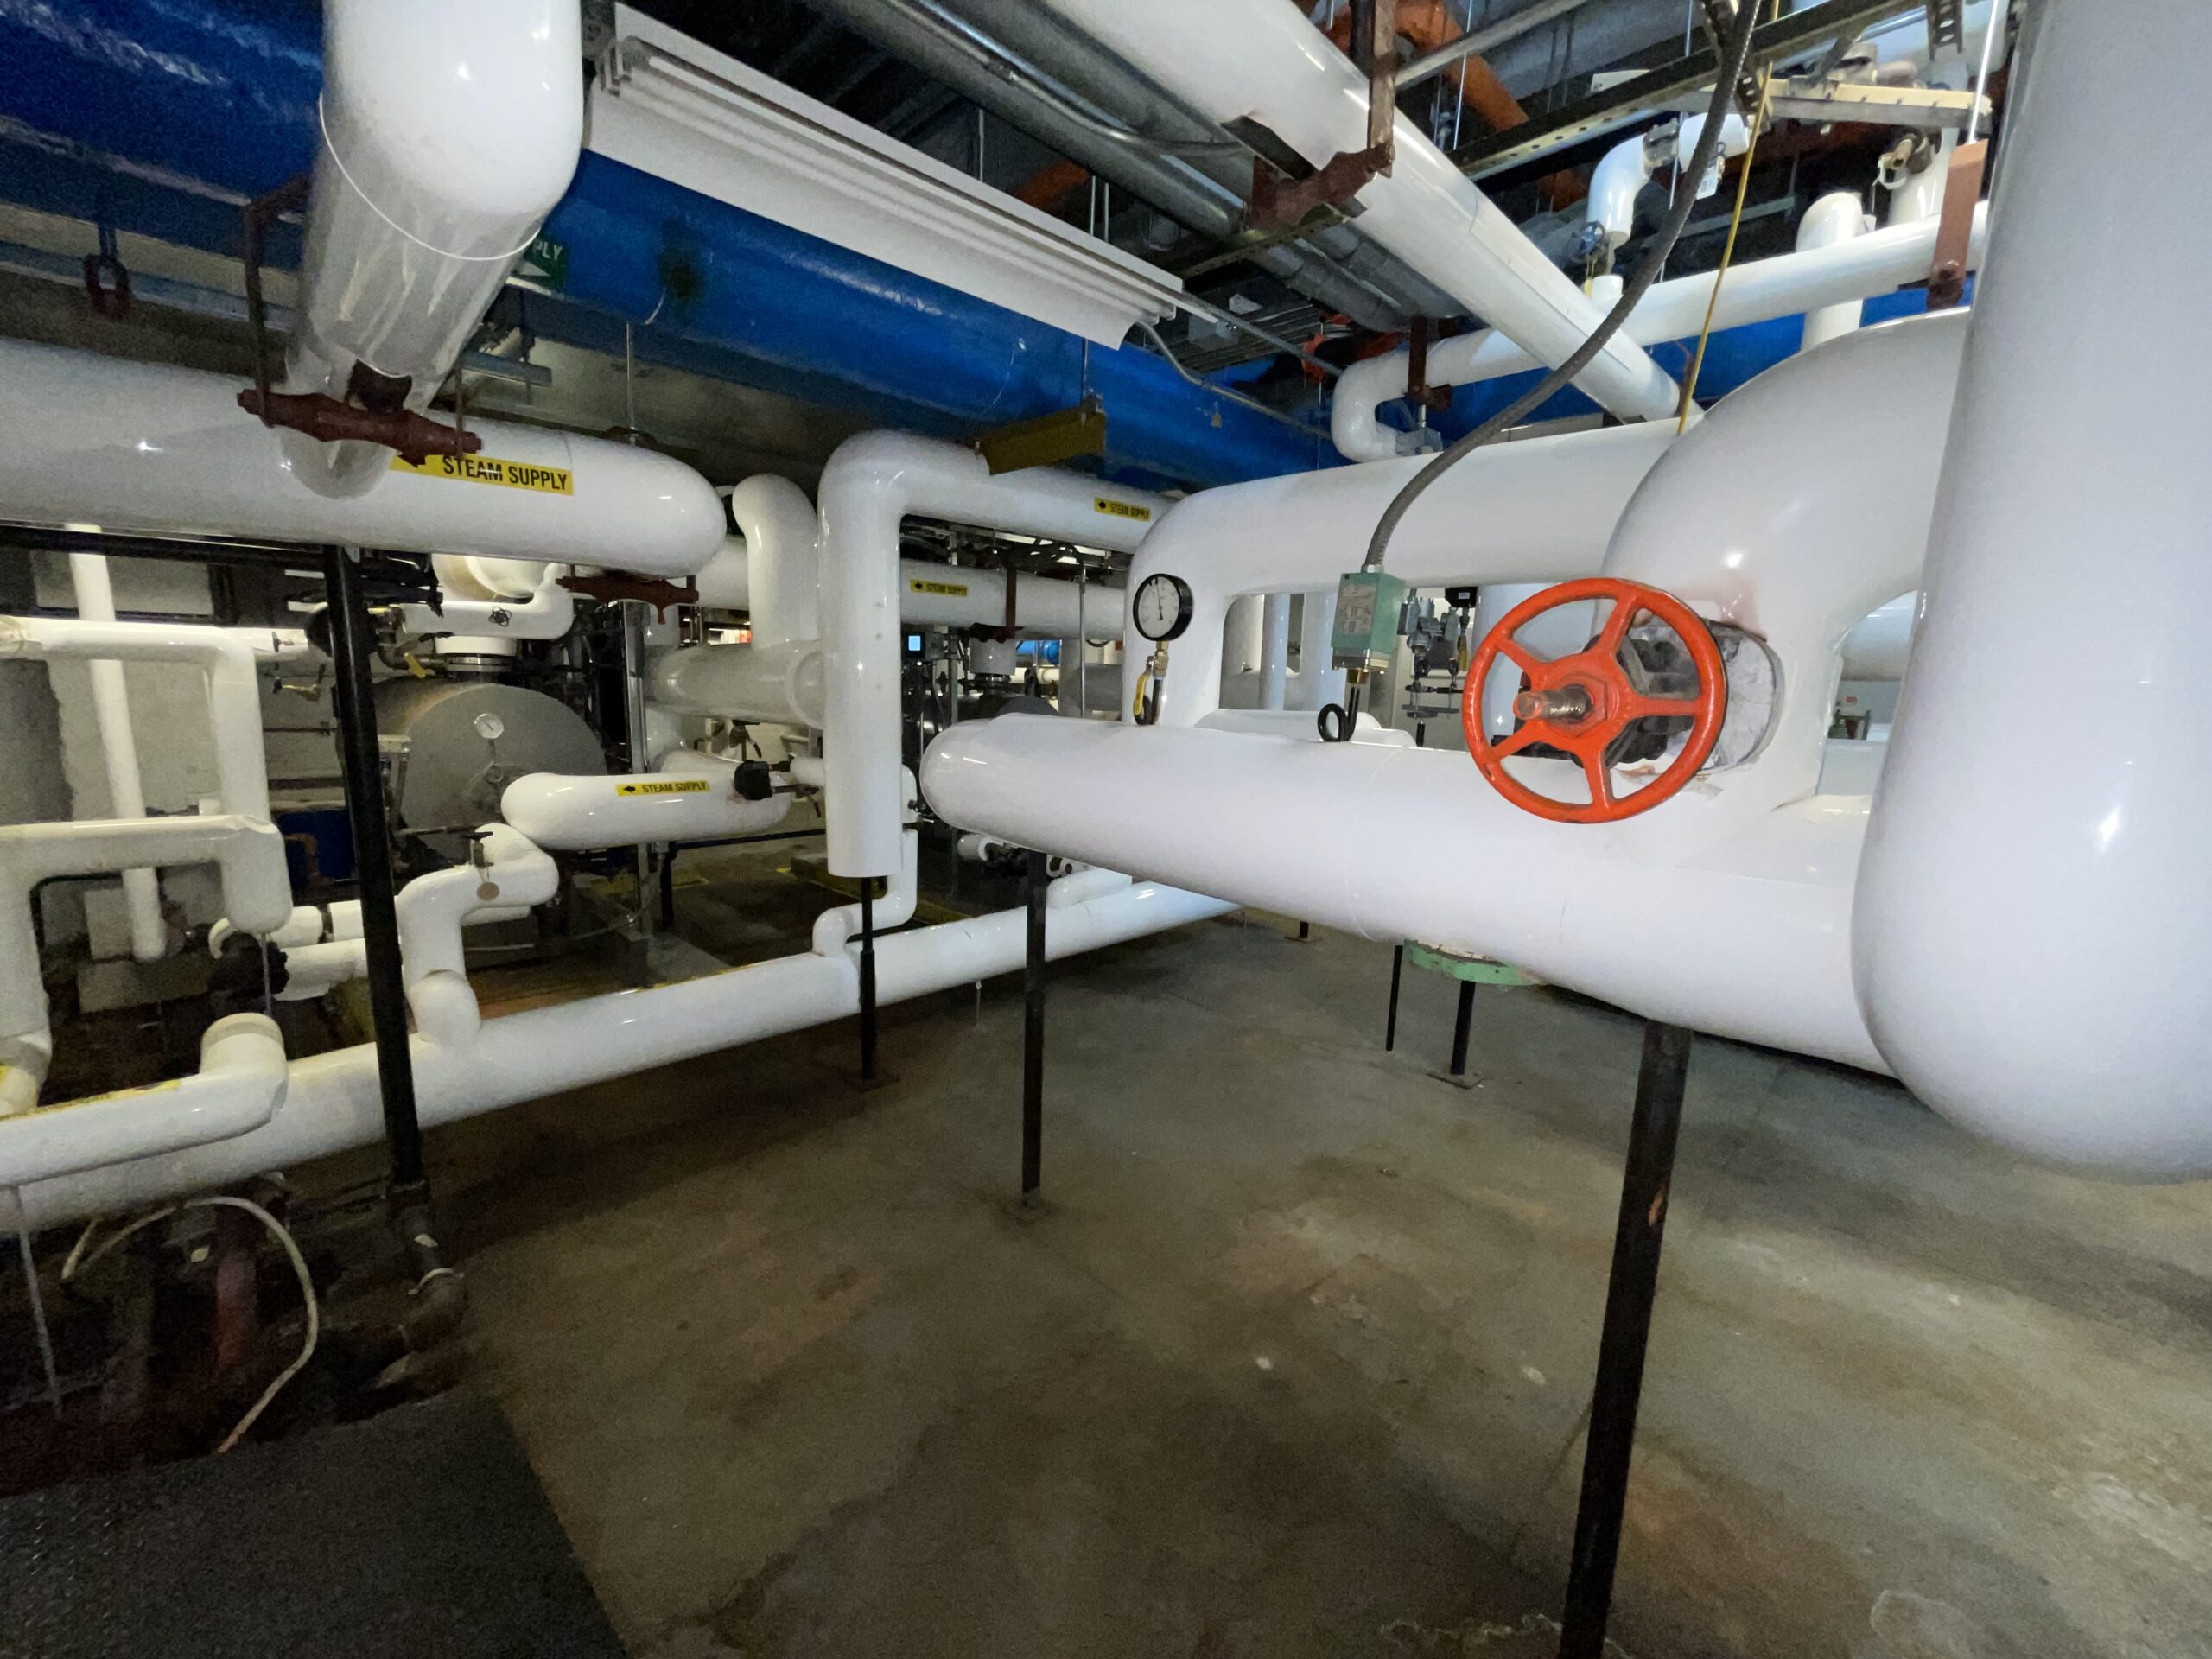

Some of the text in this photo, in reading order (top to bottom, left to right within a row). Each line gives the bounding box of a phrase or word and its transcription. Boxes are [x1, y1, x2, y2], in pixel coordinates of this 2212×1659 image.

[442, 455, 567, 491] STEAM SUPPLY
[642, 781, 706, 793] STEAM SUPPLY
